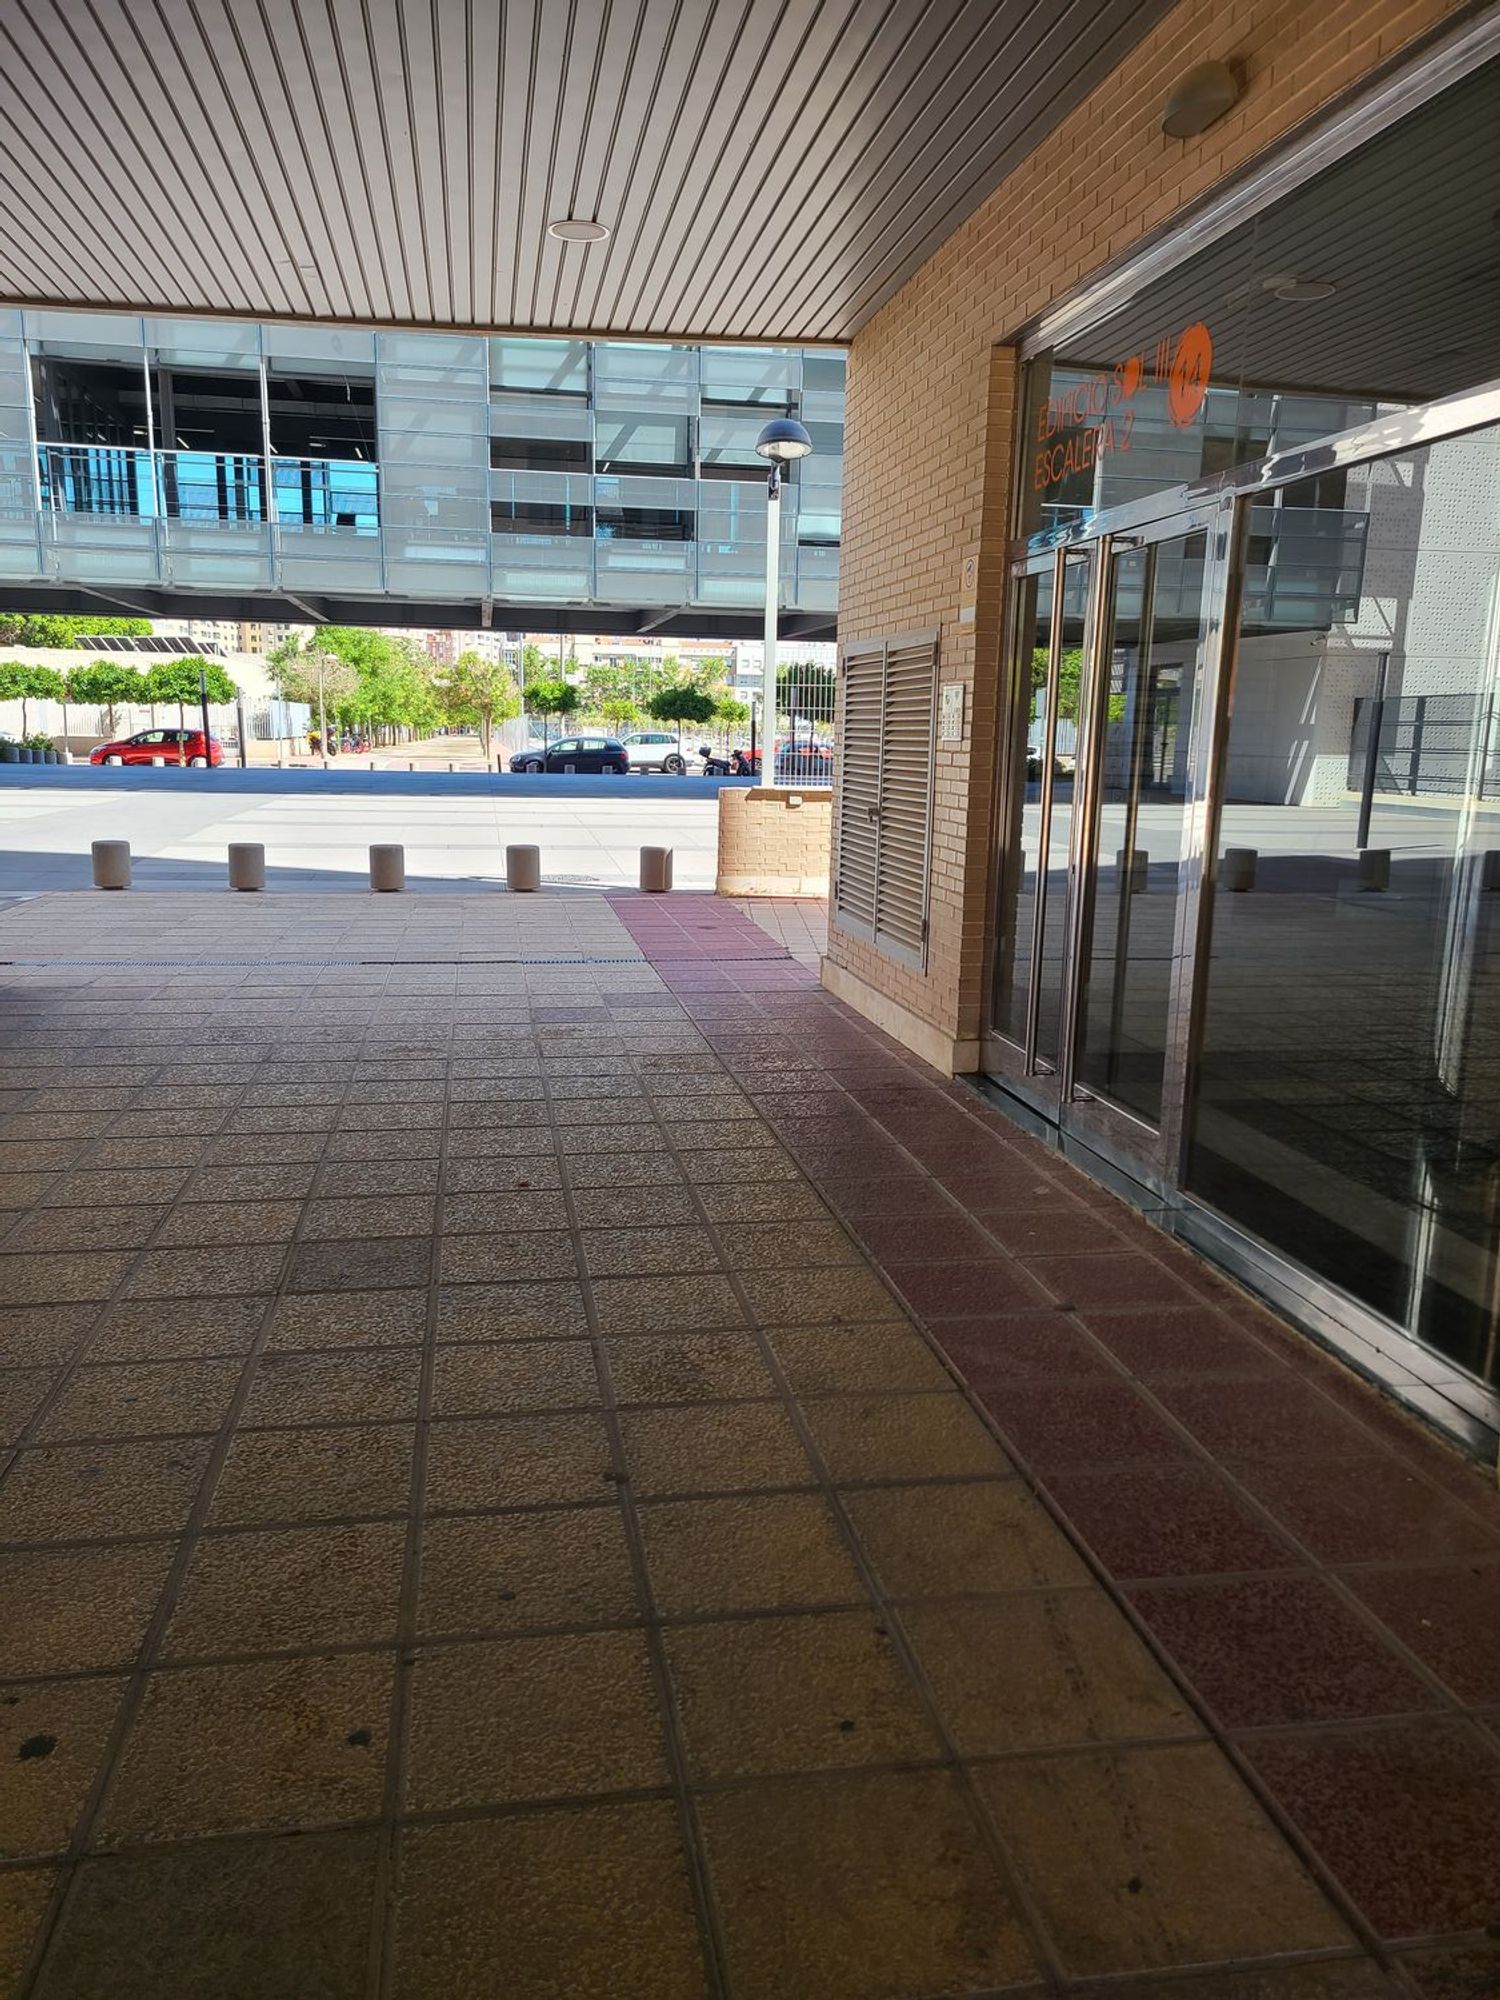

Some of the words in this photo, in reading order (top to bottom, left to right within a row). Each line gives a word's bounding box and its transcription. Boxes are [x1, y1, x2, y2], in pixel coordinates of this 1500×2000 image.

[1038, 373, 1108, 441] EDIFICIO
[1179, 351, 1202, 397] 14
[1035, 416, 1114, 490] ESCALERA
[1120, 409, 1134, 449] 2
